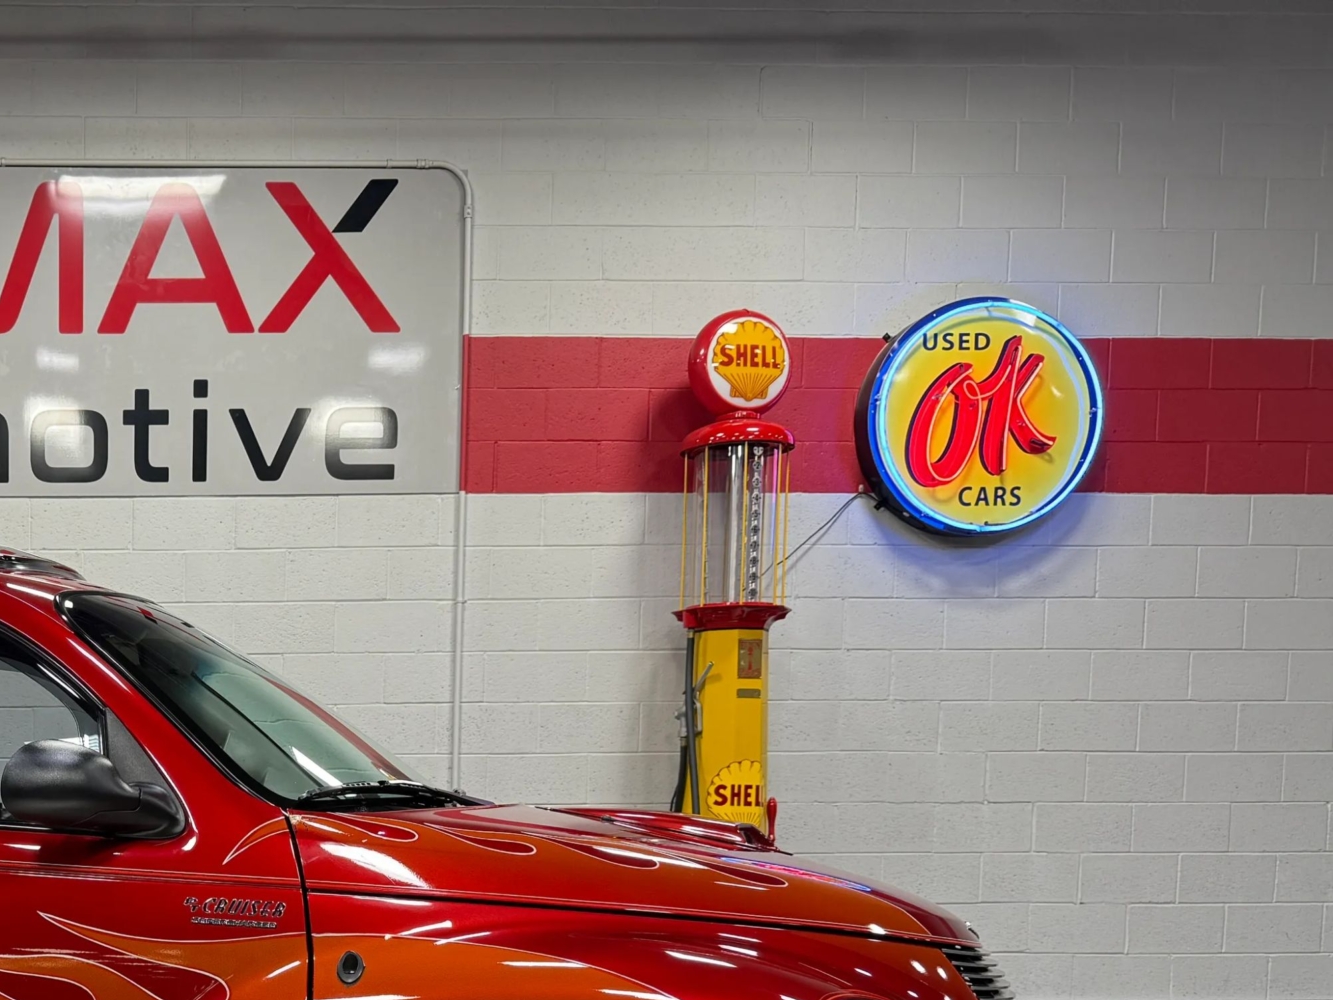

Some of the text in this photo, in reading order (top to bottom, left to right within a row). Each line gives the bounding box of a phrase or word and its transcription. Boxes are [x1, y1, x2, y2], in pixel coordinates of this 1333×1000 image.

[922, 332, 991, 351] USED
[719, 344, 781, 369] SHELL
[904, 335, 1057, 488] OK
[958, 486, 1022, 507] CARS
[202, 897, 286, 918] CRUISER
